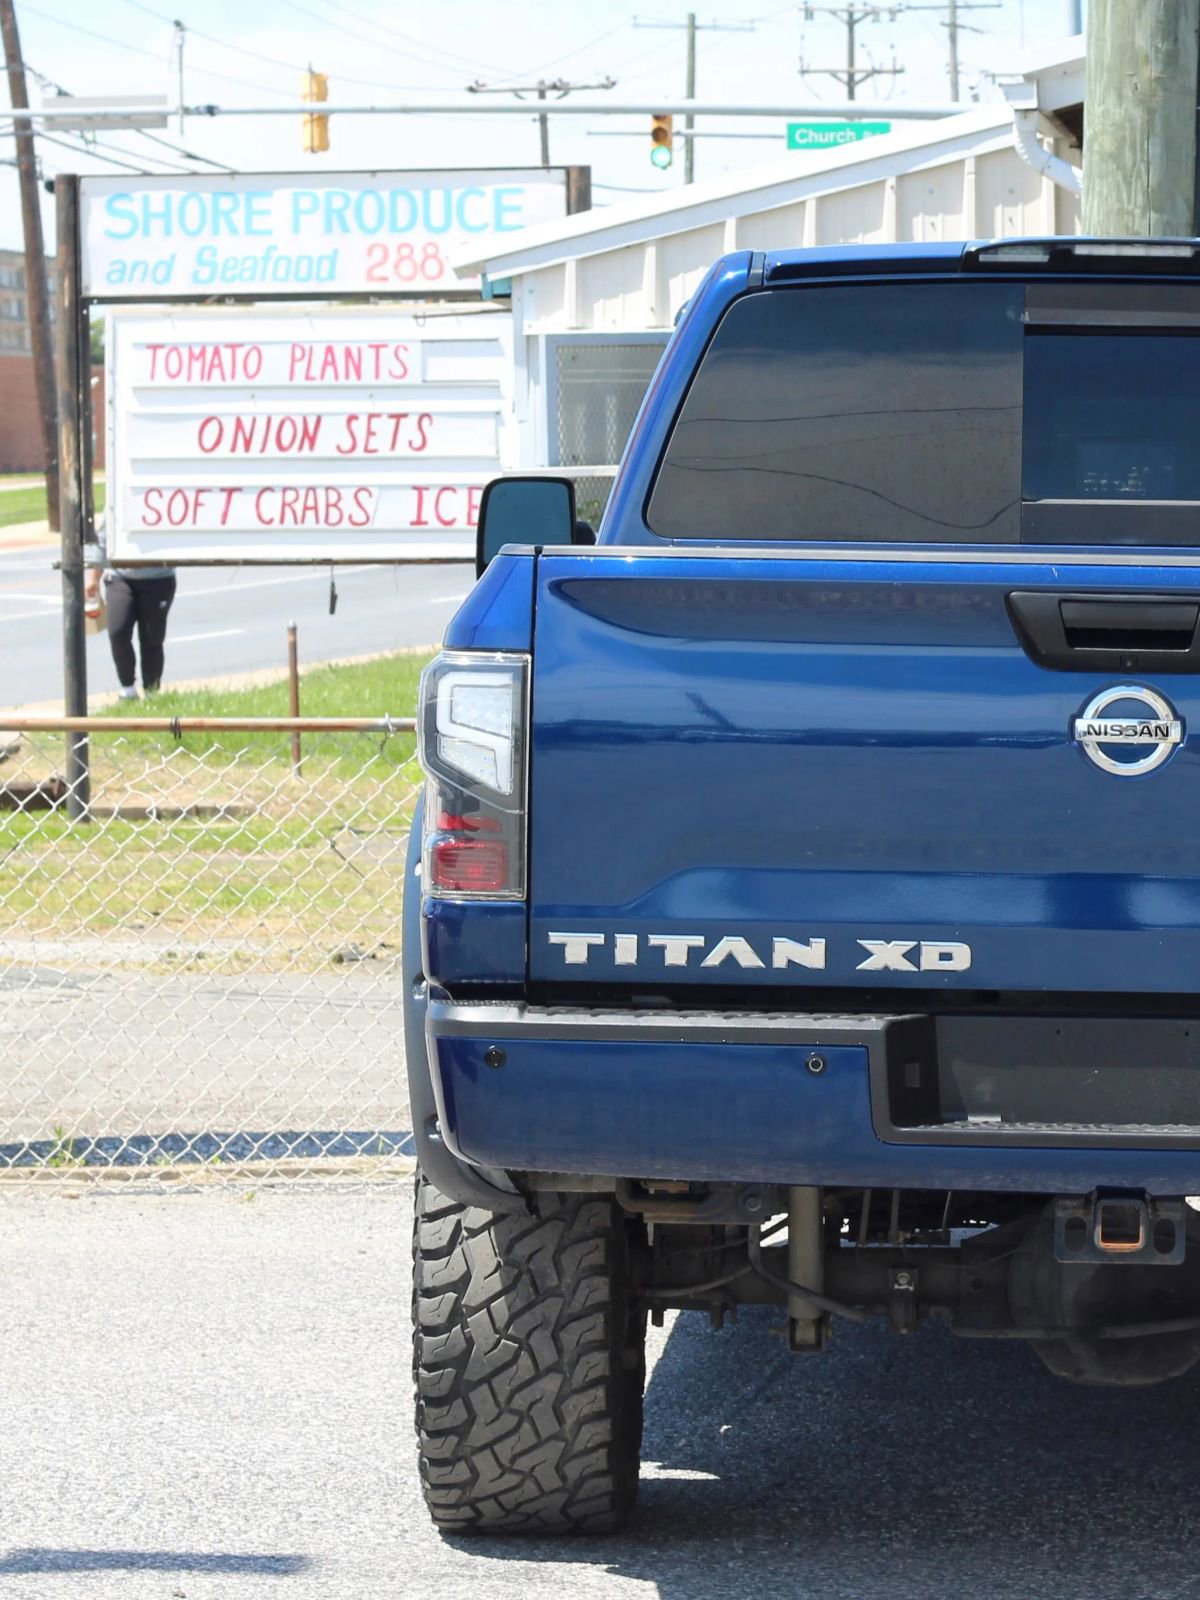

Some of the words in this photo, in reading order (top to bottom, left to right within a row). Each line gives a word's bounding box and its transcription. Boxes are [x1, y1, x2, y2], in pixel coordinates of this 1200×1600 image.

[795, 128, 857, 144] Church
[104, 191, 273, 239] SHORE
[291, 187, 527, 235] PRODUCE
[105, 252, 176, 285] and
[192, 245, 339, 284] Seafood
[146, 344, 262, 382] TOMATO
[289, 343, 409, 382] PLANTS
[198, 415, 322, 453] ONION
[336, 414, 433, 454] SETS
[142, 487, 243, 526] SOFT
[256, 486, 373, 526] CRABS
[1086, 723, 1169, 738] NISSAN
[548, 931, 826, 969] TITAN
[856, 939, 972, 971] XD
